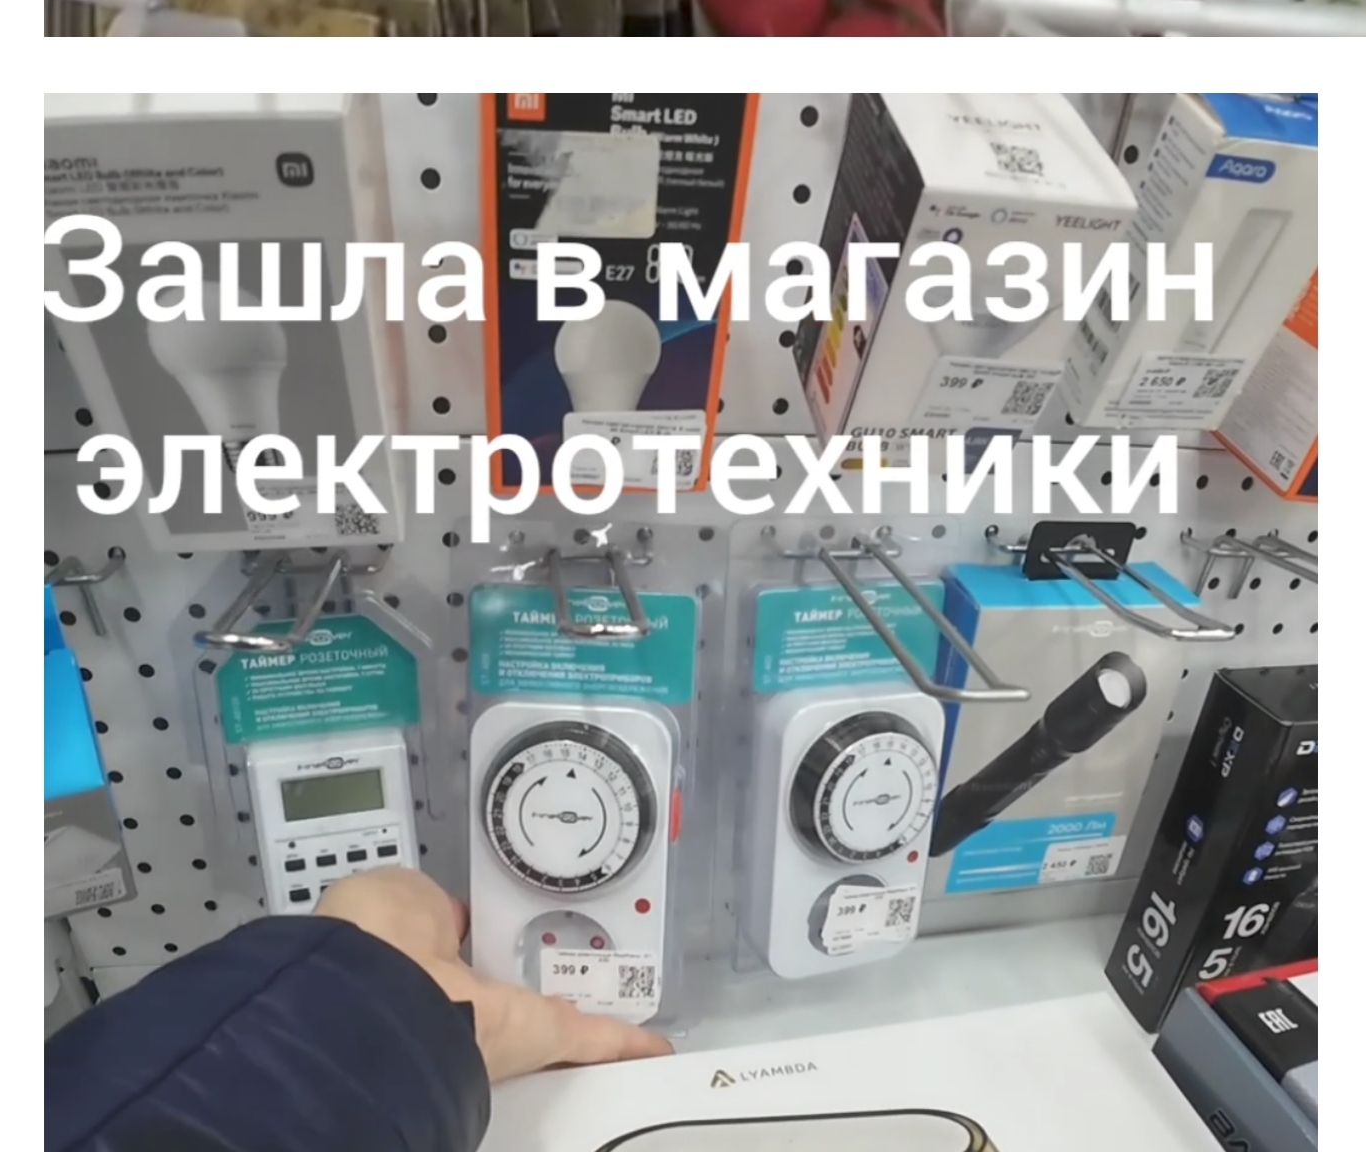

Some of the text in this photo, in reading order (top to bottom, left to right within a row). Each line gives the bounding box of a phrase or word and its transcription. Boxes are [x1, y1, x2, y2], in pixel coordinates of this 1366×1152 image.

[609, 105, 698, 126] Smart LED
[1218, 158, 1267, 179] Aqara
[605, 265, 636, 282] E27
[850, 426, 958, 439] GU10 SMART
[512, 609, 556, 625] ТАЙМ
[793, 608, 843, 624] ТАЙМЕР
[240, 644, 389, 670] ТАЙМЕР РОЗЕТОЧНЫЙ
[1047, 822, 1084, 836] 2000
[1142, 891, 1178, 947] 16
[1223, 903, 1270, 940] 16
[552, 963, 577, 976] 399
[1126, 944, 1154, 988] 5
[1198, 947, 1234, 980] 5
[740, 1060, 819, 1083] LYAMBDA
